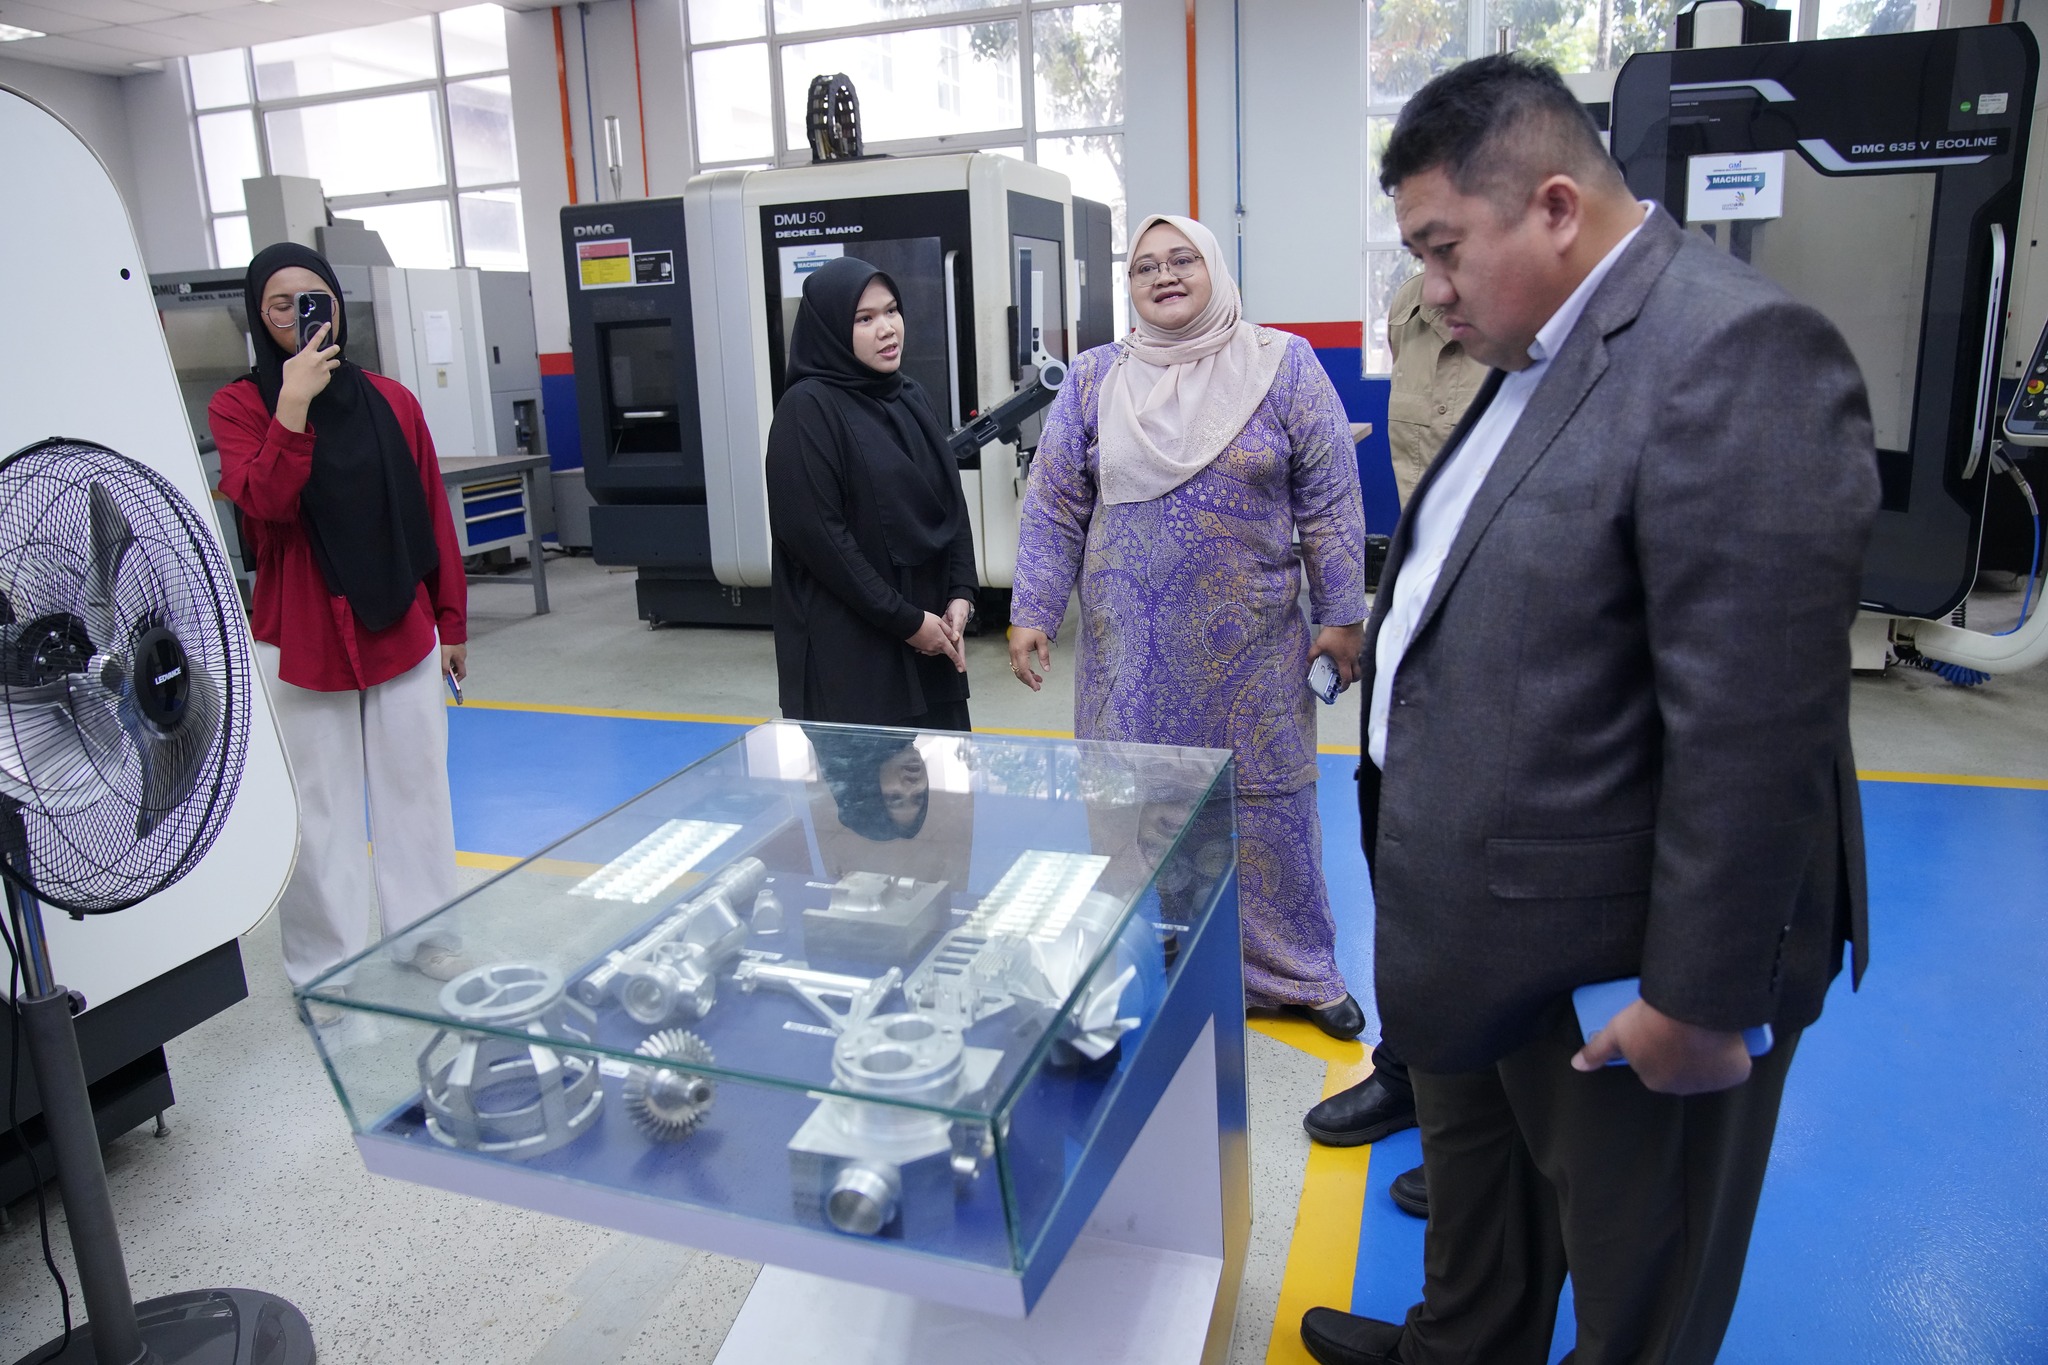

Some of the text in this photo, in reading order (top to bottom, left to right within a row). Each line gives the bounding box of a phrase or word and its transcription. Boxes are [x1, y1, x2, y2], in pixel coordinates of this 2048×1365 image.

[1851, 136, 1998, 154] DMC 635 V ECOLINE
[1712, 174, 1760, 184] MACHINE 2
[774, 211, 826, 226] DMU 50
[573, 223, 615, 237] DMG
[775, 225, 863, 238] DECKEL MAHO
[179, 283, 192, 294] 50
